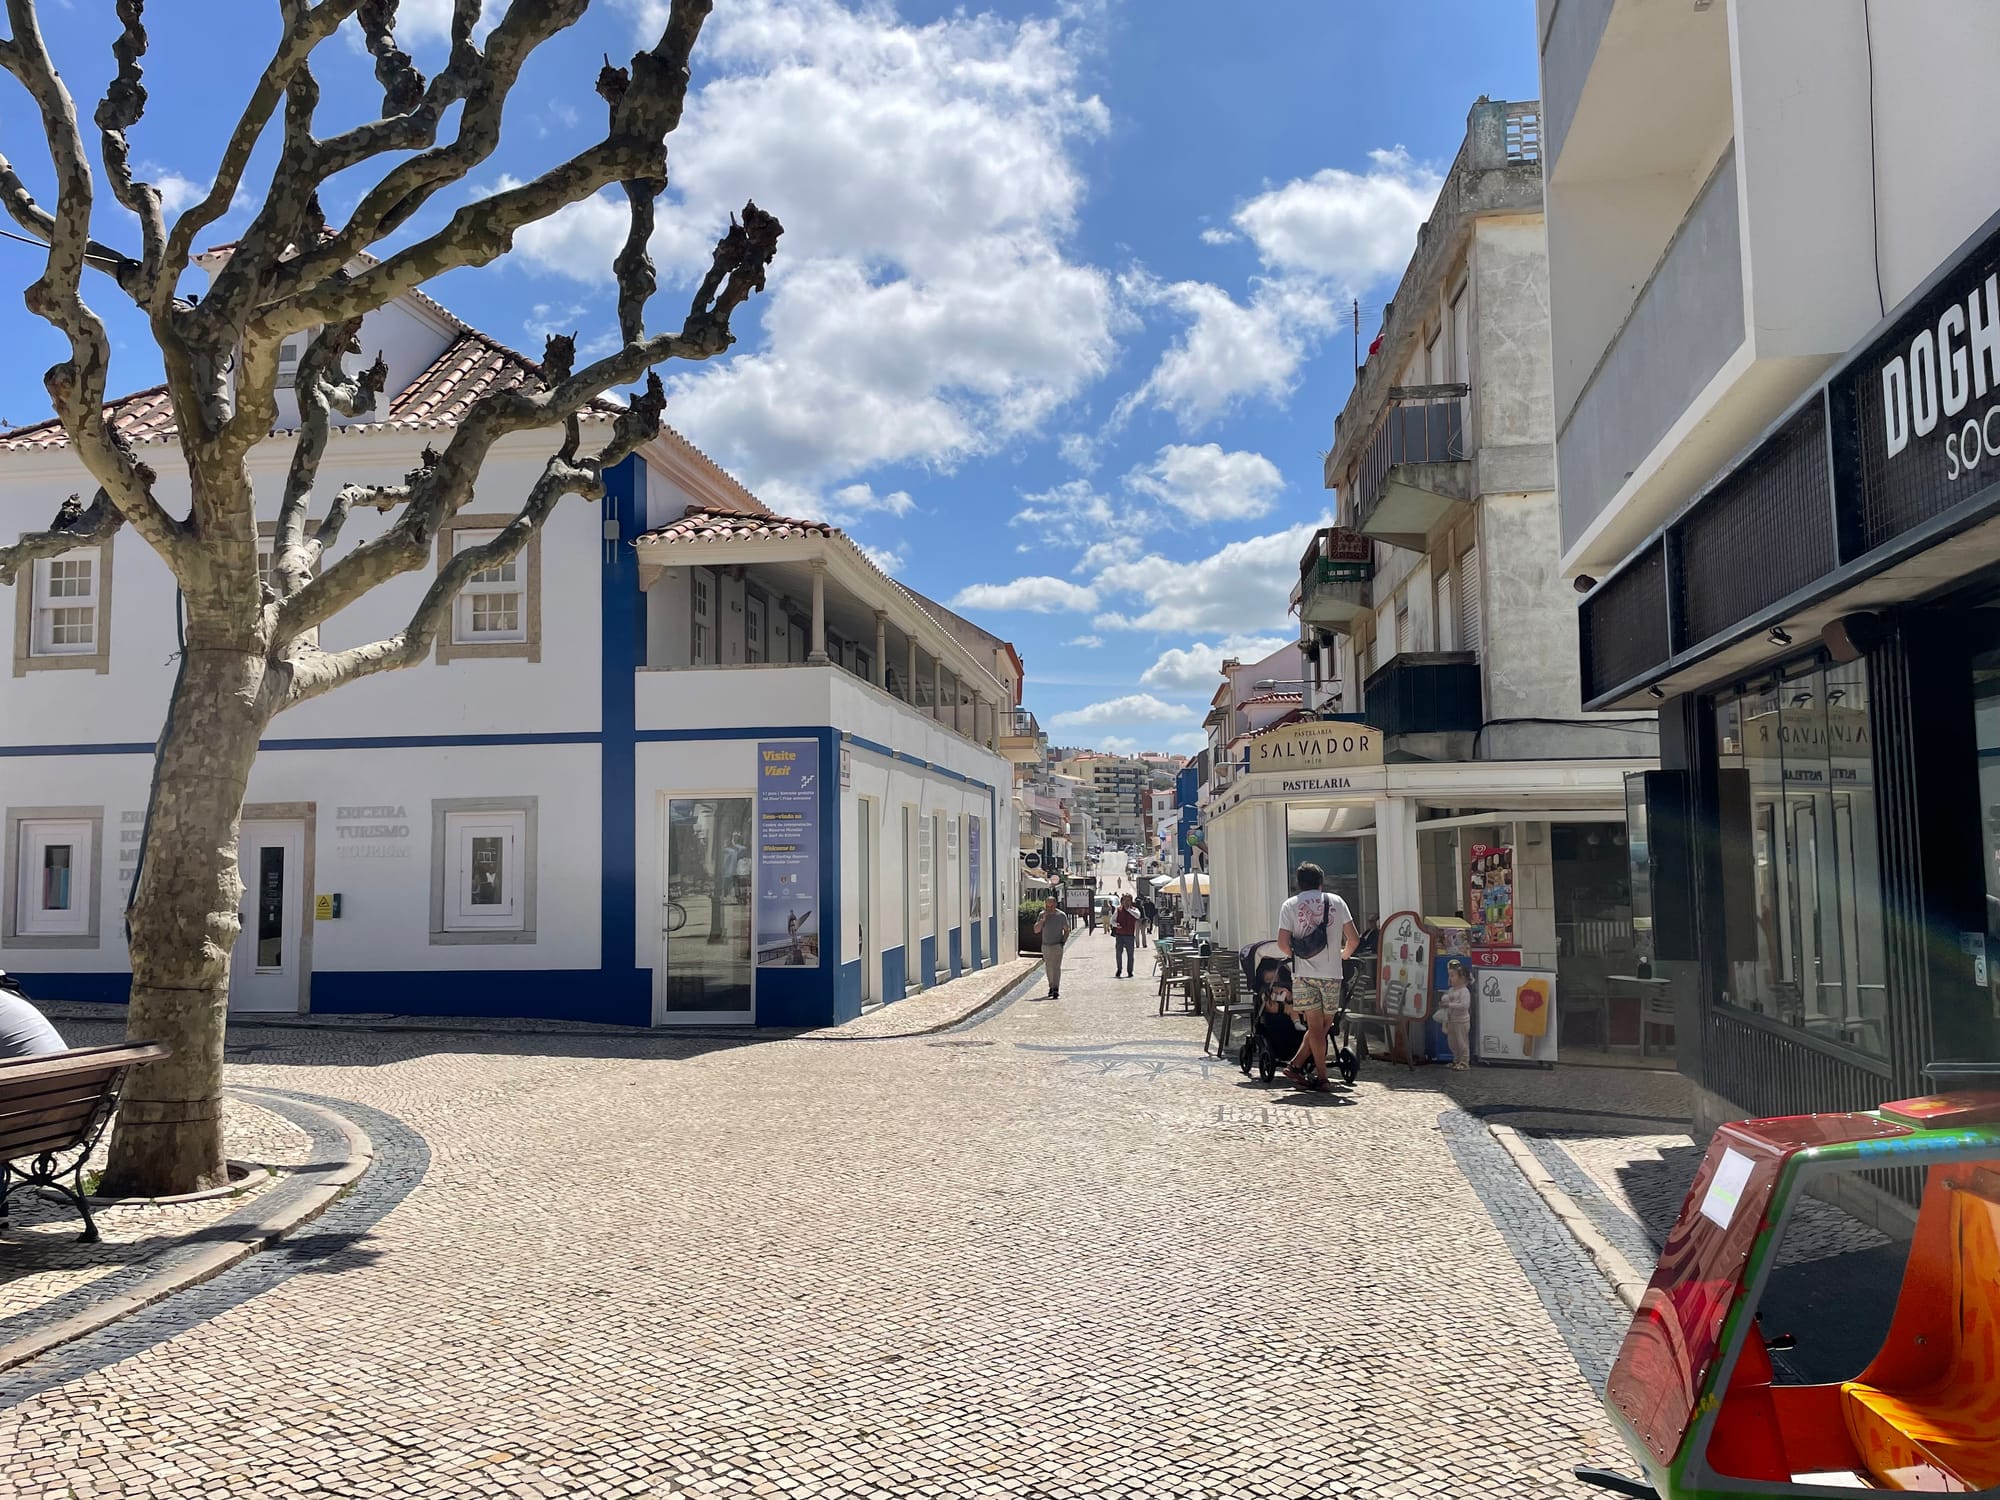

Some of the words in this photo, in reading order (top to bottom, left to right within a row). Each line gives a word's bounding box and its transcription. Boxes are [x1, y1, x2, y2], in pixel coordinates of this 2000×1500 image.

[1294, 728, 1333, 737] PASTELARIA
[1260, 735, 1369, 759] SALVADOR
[762, 750, 796, 761] Visite
[764, 765, 791, 776] Visit
[1282, 778, 1351, 791] PASTELARIA
[336, 805, 408, 819] ERICEIRA
[336, 825, 410, 838] TURISMO
